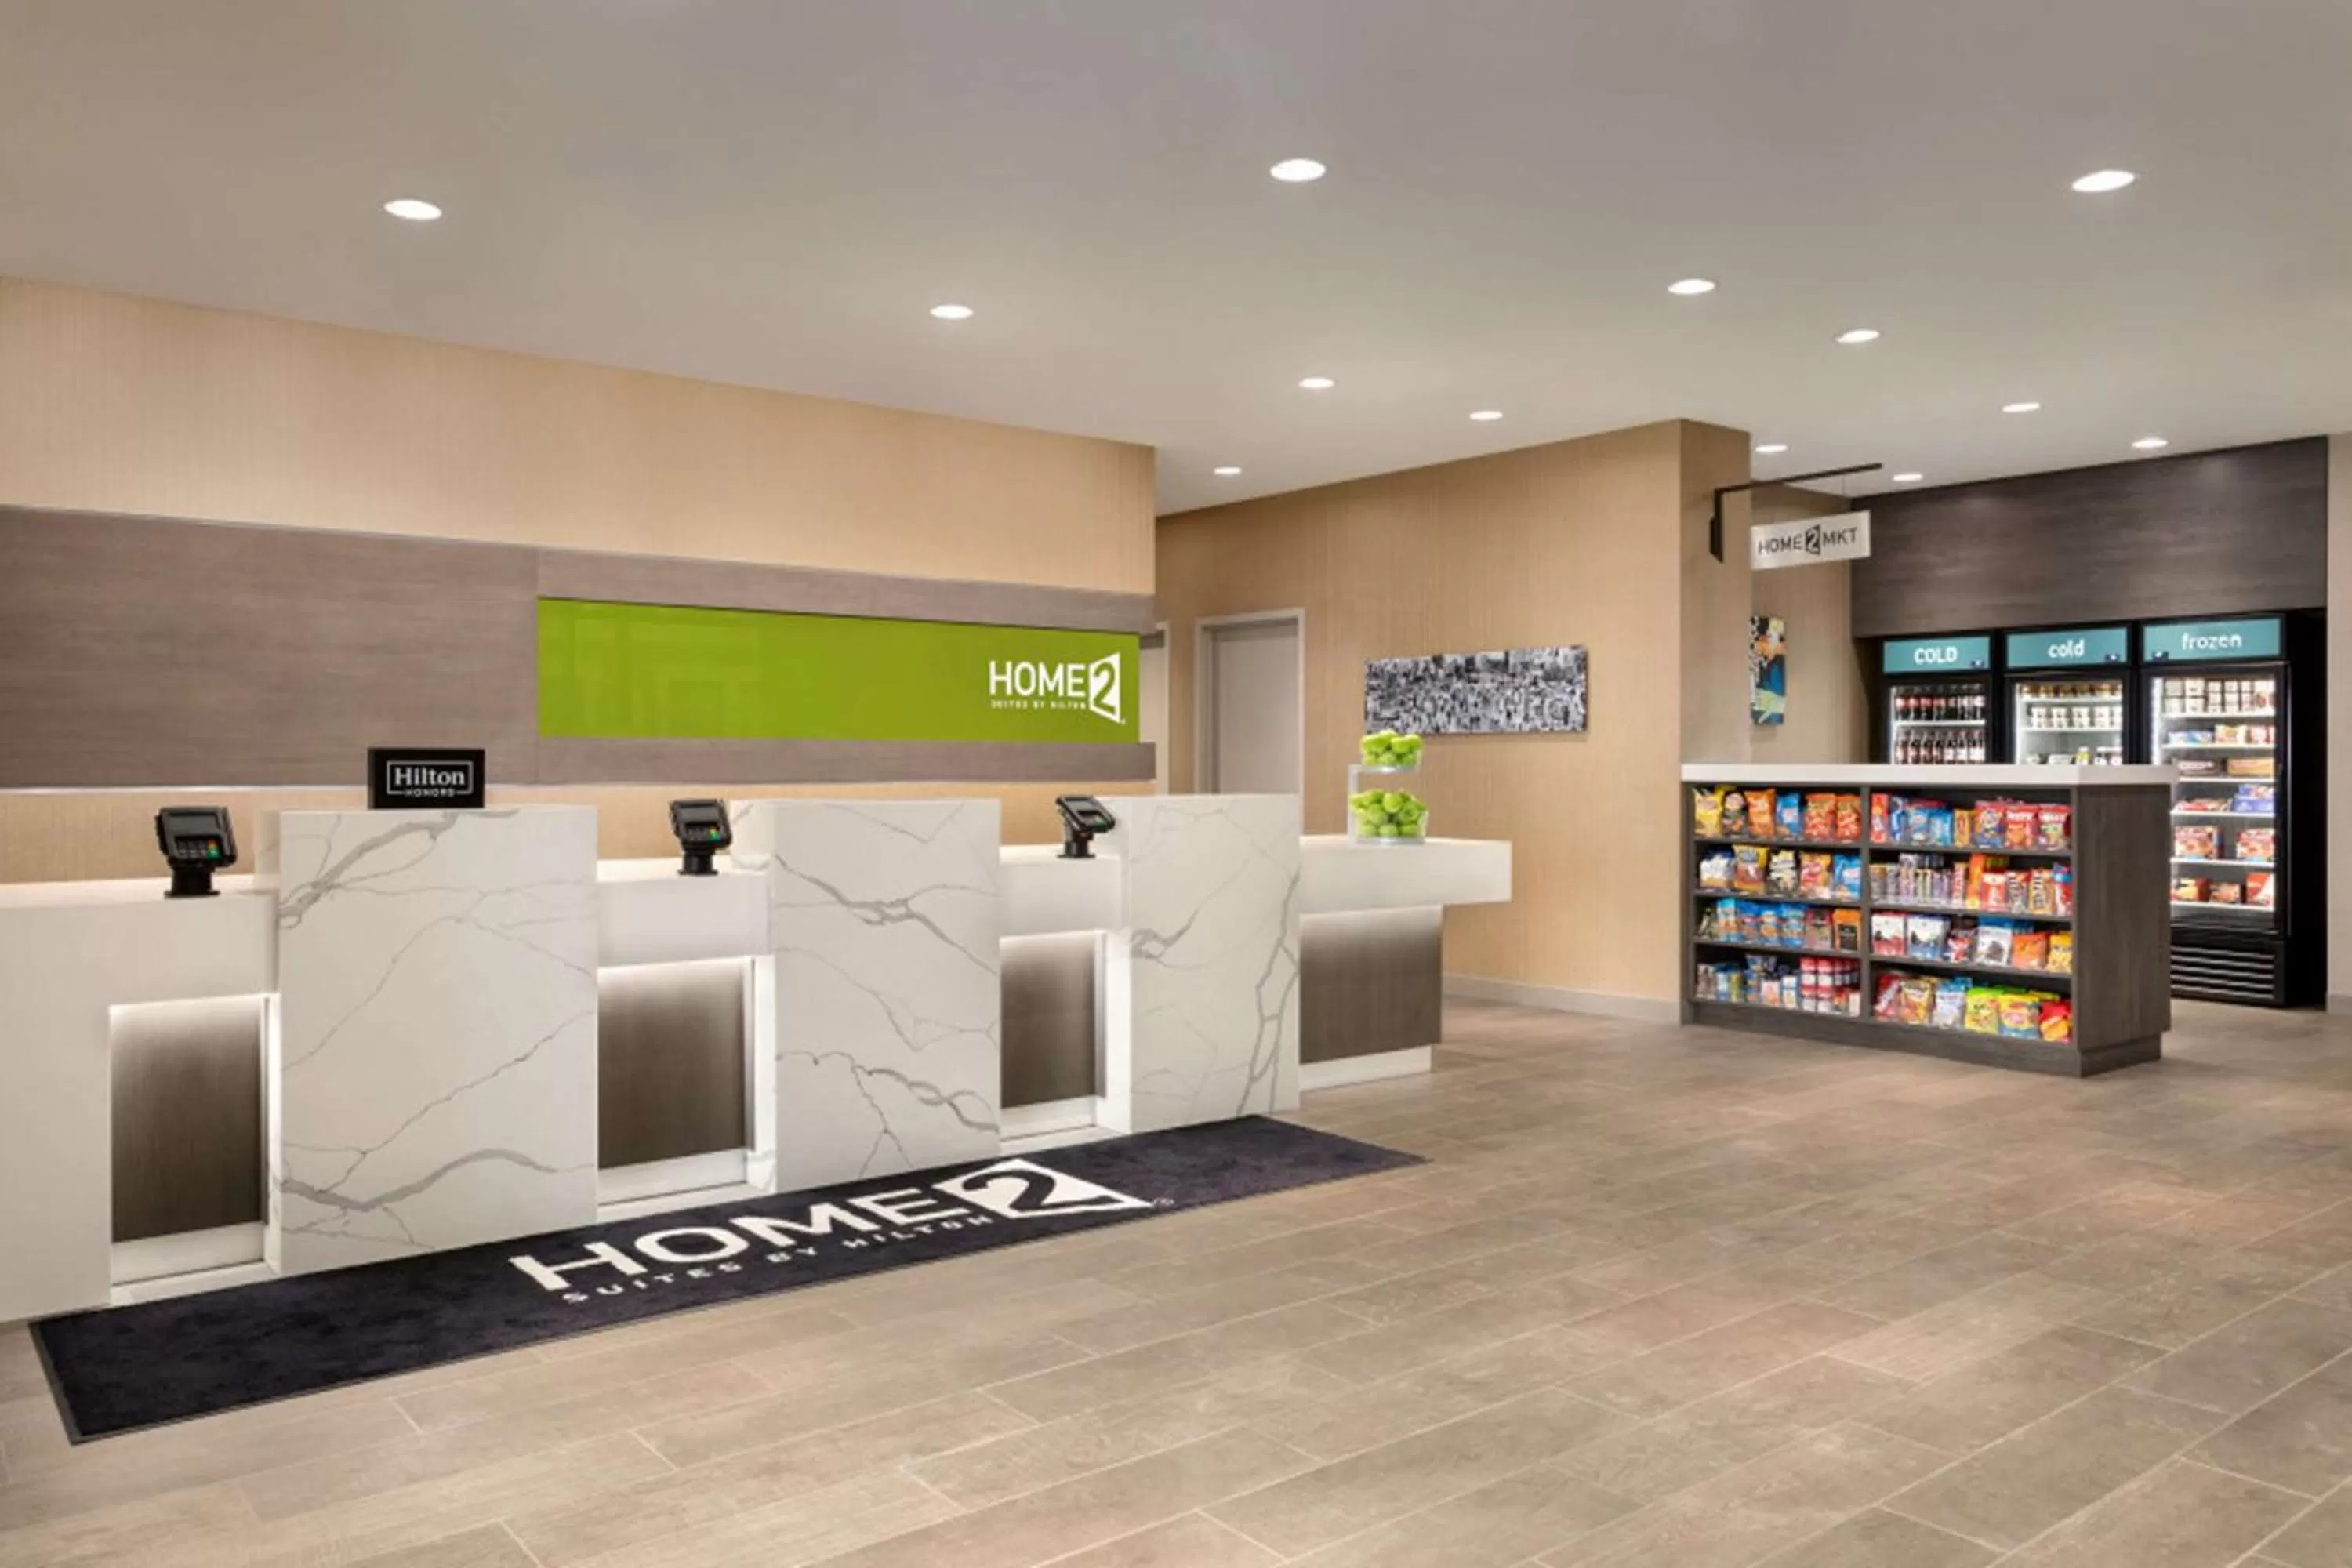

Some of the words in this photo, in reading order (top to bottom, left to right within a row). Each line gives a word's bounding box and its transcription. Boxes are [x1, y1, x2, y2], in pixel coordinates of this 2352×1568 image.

[2047, 639, 2085, 658] cold
[2182, 633, 2243, 650] frozen
[1914, 645, 1958, 665] COLD
[991, 699, 1028, 709] SUITES
[1033, 700, 1045, 710] BY
[394, 767, 465, 786] Hilton
[405, 788, 455, 797] HONORS
[562, 1261, 742, 1304] SUITES
[766, 1246, 817, 1263] BY
[841, 1214, 993, 1249] HILTON
